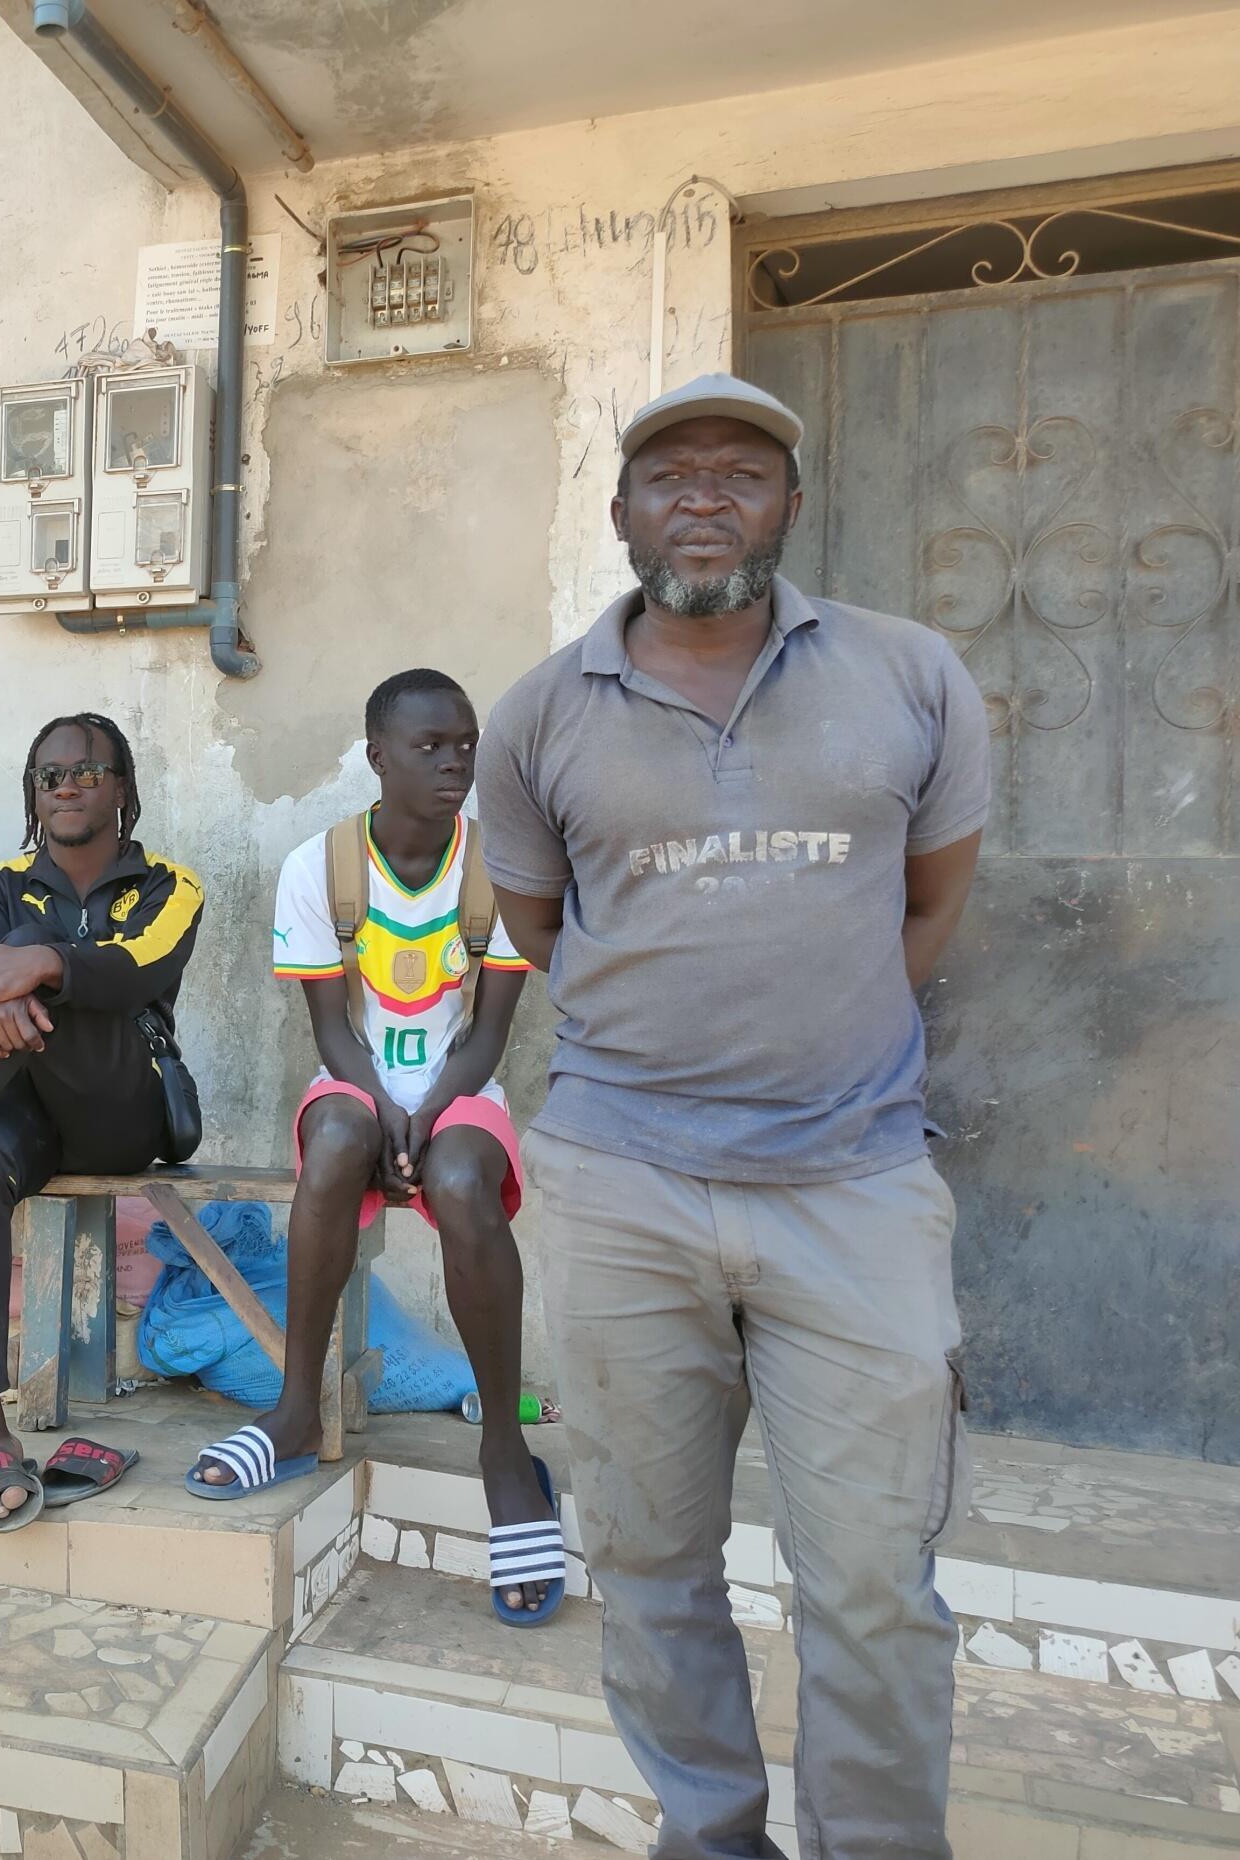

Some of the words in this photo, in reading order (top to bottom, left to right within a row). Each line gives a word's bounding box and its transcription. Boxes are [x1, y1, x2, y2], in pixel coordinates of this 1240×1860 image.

[628, 830, 852, 876] FINALISTE
[113, 893, 136, 914] BVB
[383, 1025, 428, 1070] 10
